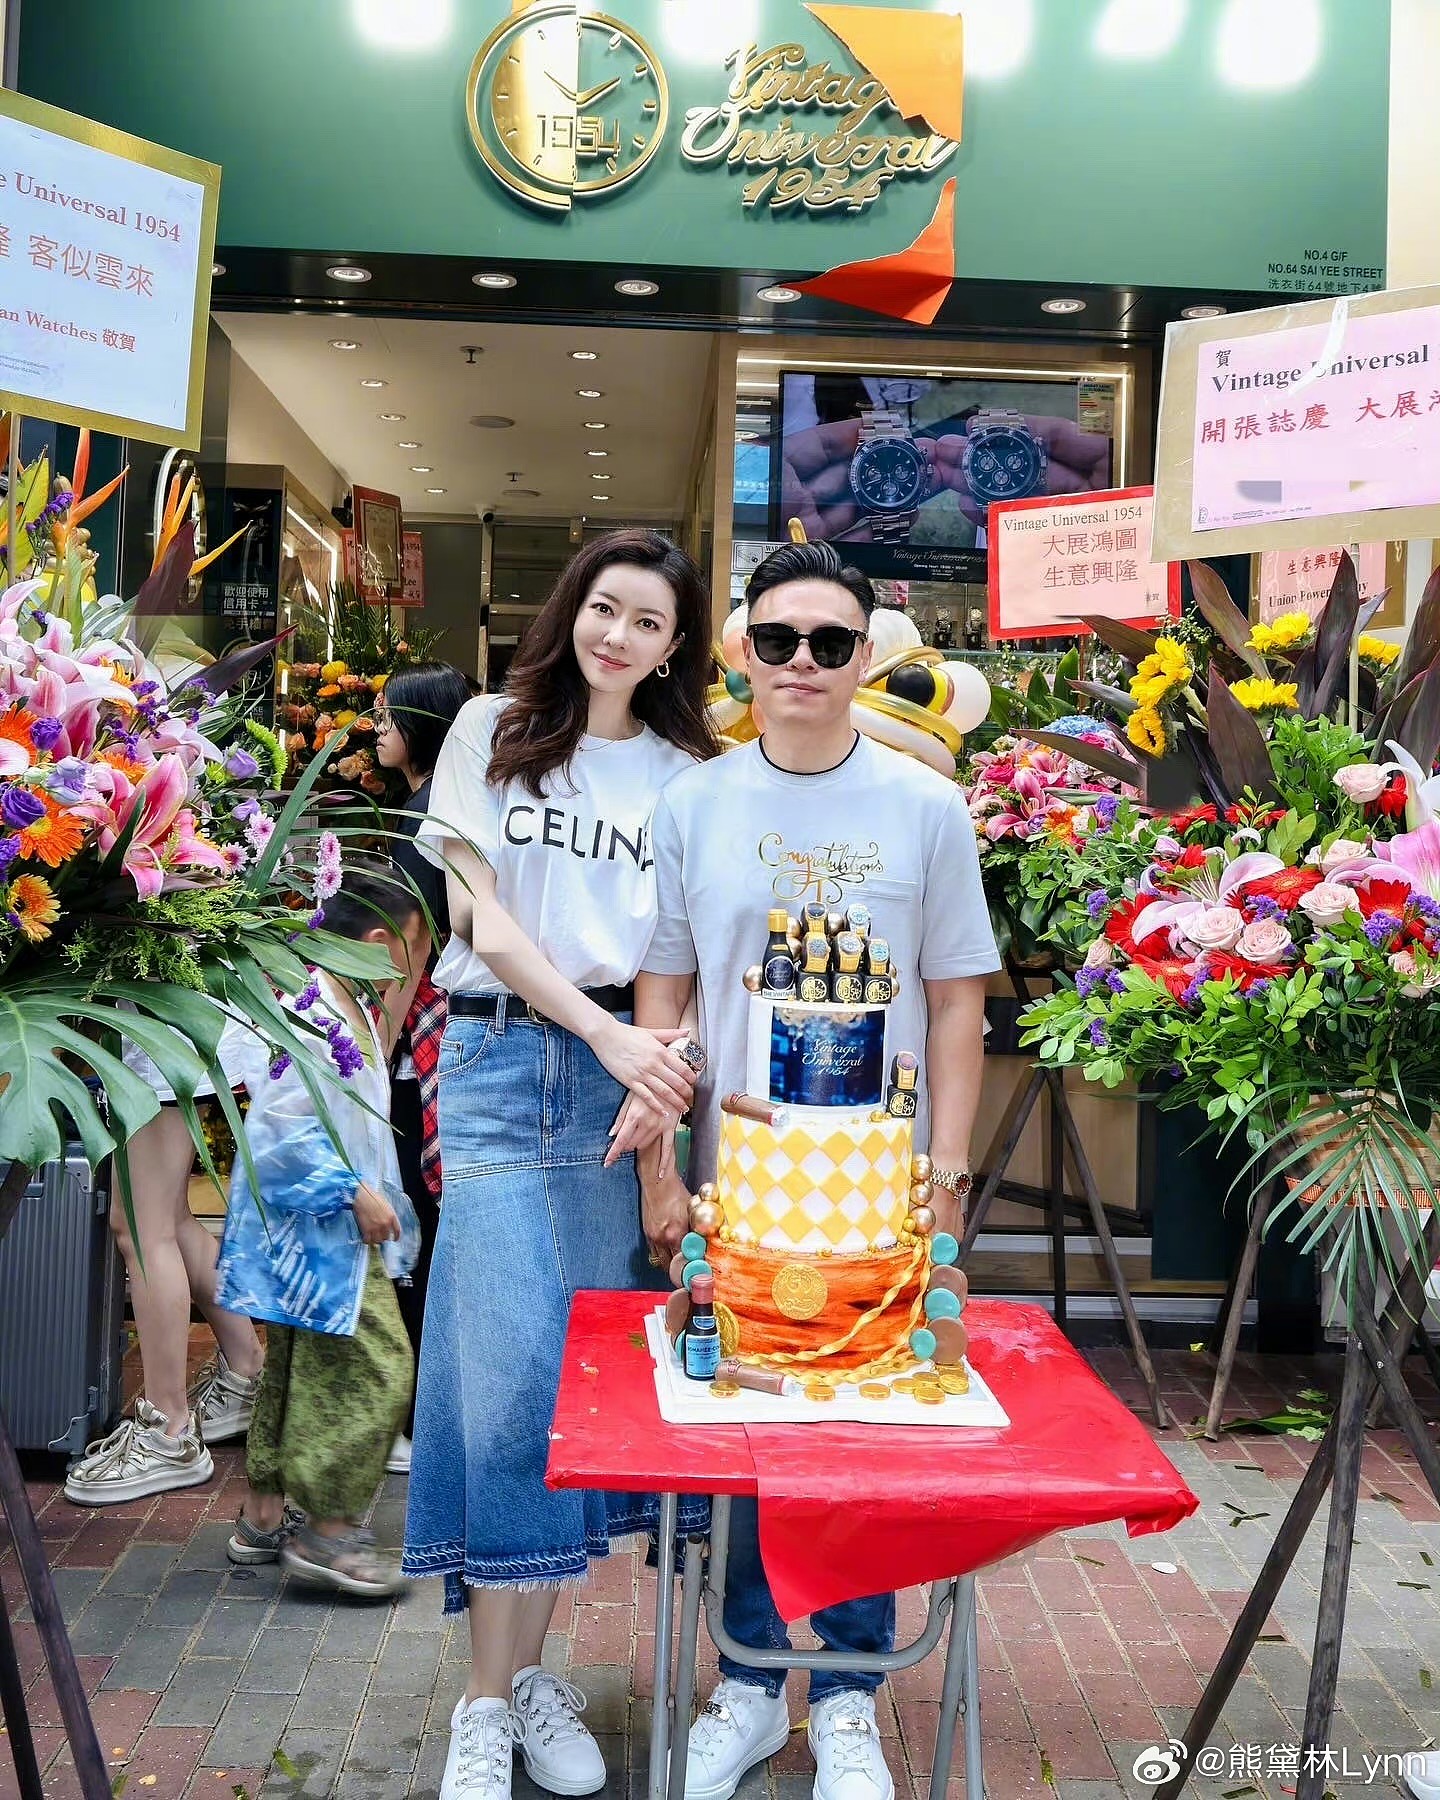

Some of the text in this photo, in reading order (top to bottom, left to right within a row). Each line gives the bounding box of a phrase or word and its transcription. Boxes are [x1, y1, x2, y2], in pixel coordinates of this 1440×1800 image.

[725, 44, 899, 134] Vintag
[536, 114, 620, 157] 1954
[682, 106, 960, 172] Universal
[742, 167, 895, 212] 1954
[15, 172, 127, 226] Universal
[135, 212, 181, 242] 1954
[27, 234, 154, 297] 客似雲來
[1304, 249, 1328, 261] NO.4
[1268, 263, 1384, 279] NO.64 SAI YEE STREET
[26, 309, 97, 343] Watches
[102, 328, 137, 353] 敬賀
[1215, 349, 1232, 368] 賀
[1211, 368, 1302, 394] Vintage
[1201, 403, 1331, 444] 開張誌慶
[1003, 506, 1142, 532] Vintage Universal 1954
[1042, 527, 1137, 558] 大展鴻圖
[1043, 559, 1139, 589] 生意興隆
[223, 597, 259, 610] 信用卡
[224, 585, 269, 598] 歡迎使用
[1268, 587, 1332, 608] Union Power
[801, 1052, 865, 1067] Universal
[814, 1038, 857, 1059] Vintage
[815, 1066, 851, 1076] 1954
